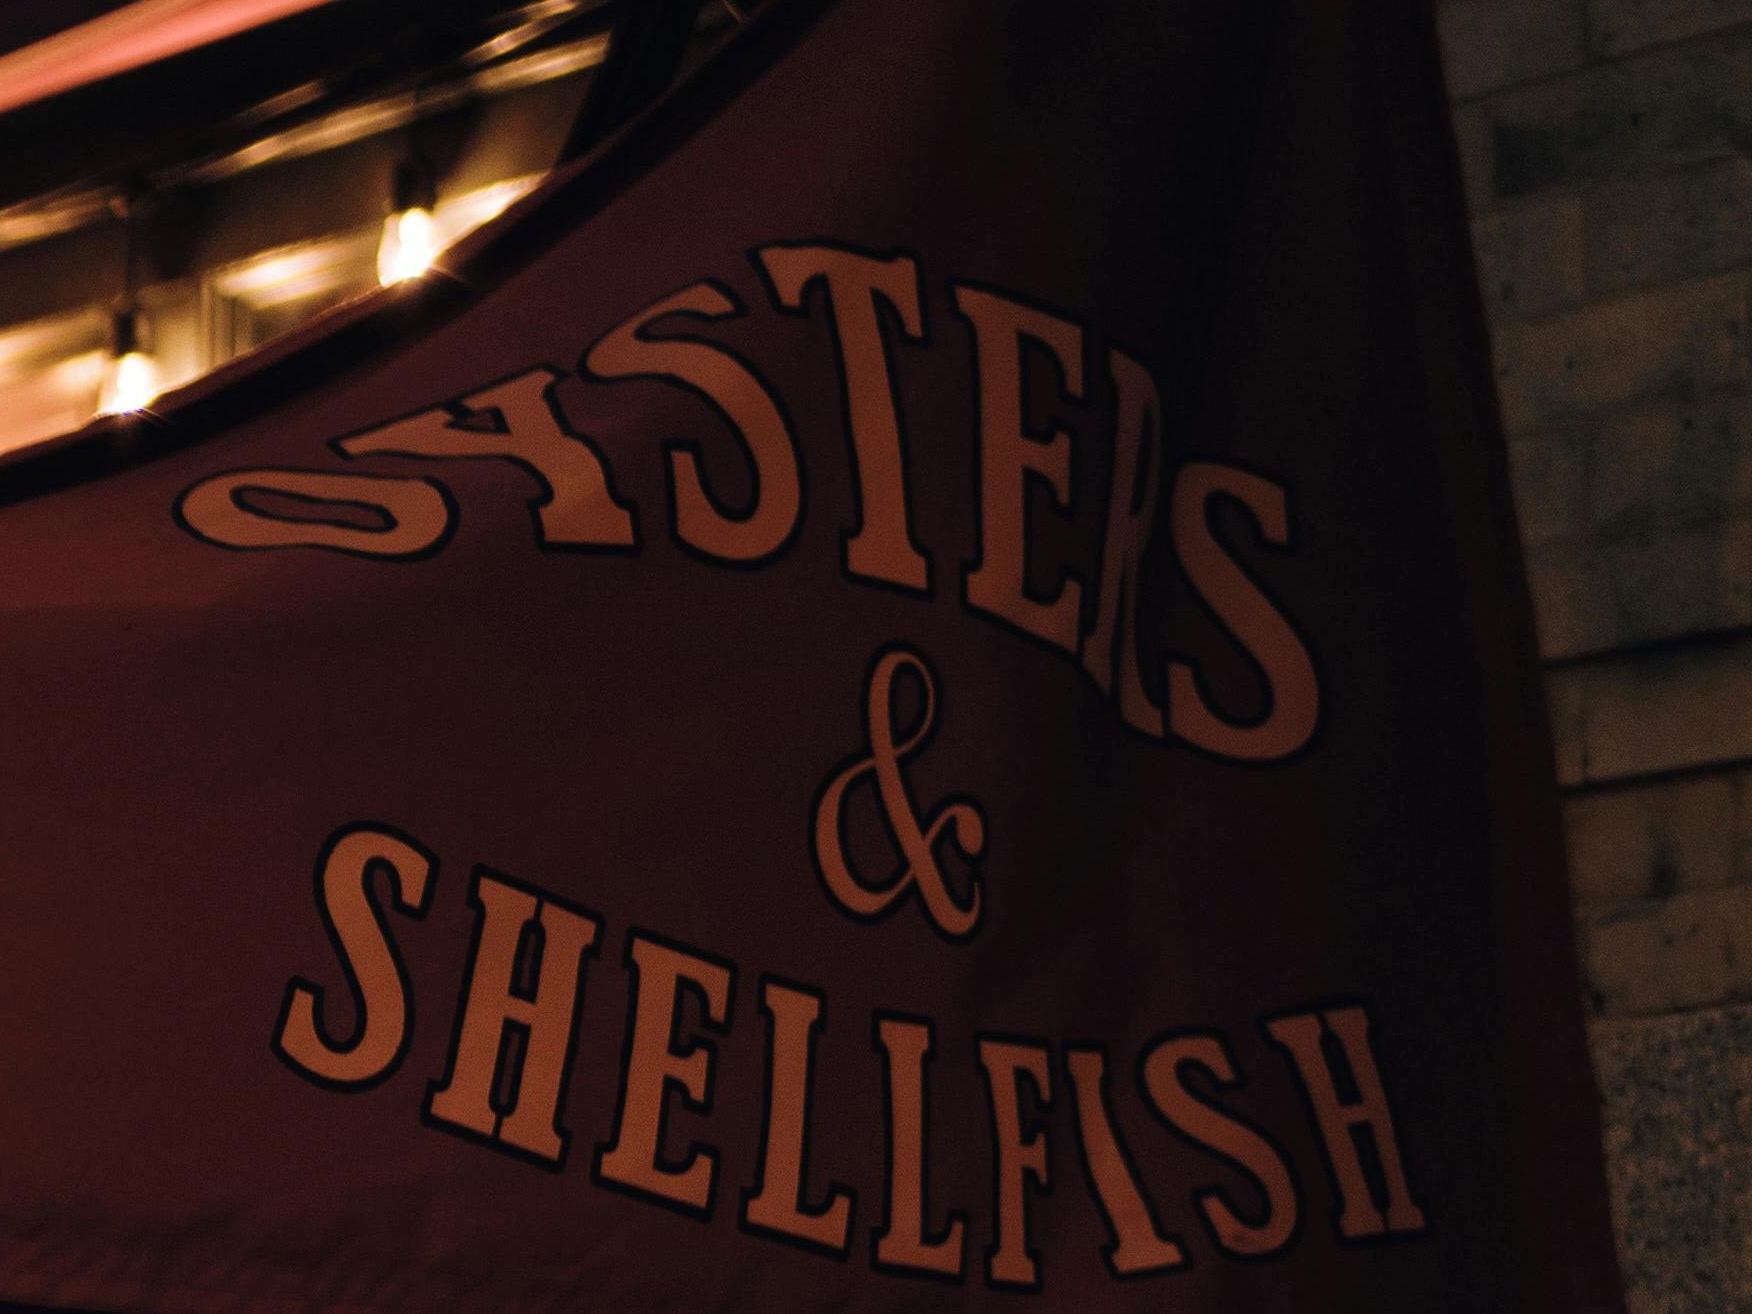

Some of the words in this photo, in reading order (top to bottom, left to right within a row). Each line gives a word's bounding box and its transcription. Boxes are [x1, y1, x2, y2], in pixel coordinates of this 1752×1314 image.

[173, 238, 1322, 768] OYSTERS
[809, 640, 989, 945] &
[268, 820, 1434, 1292] SHELLFISH
